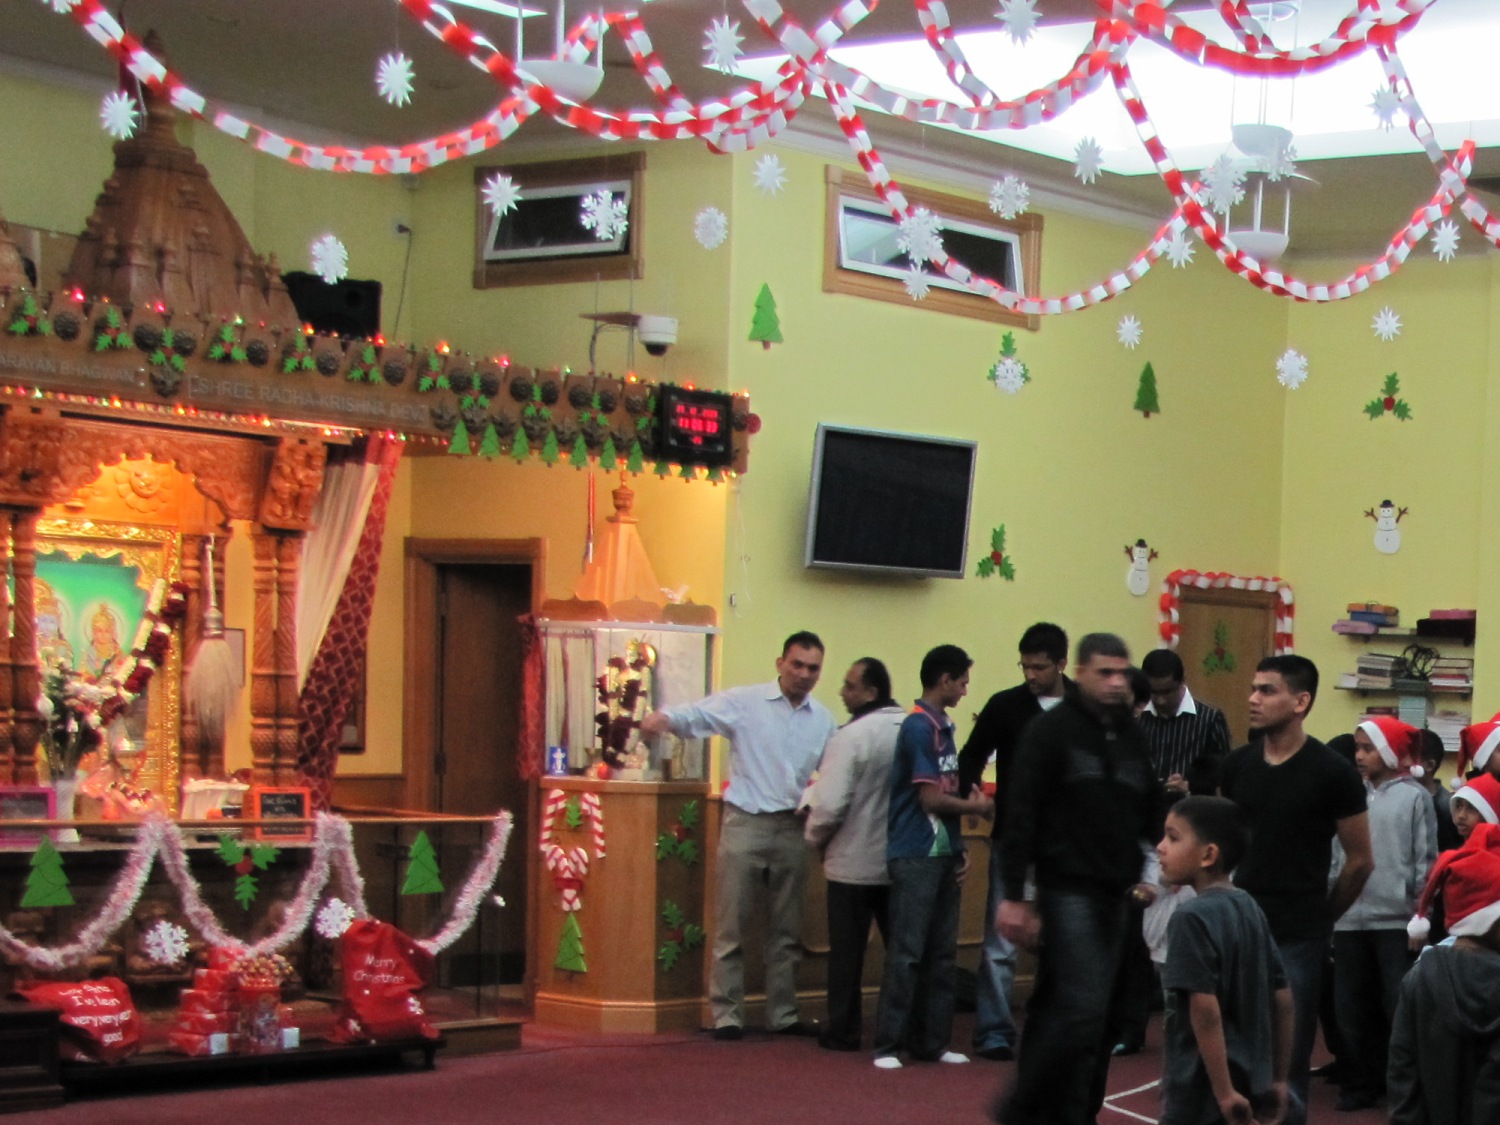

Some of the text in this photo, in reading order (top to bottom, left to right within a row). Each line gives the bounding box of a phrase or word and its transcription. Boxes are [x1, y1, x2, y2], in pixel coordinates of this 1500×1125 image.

[198, 377, 255, 401] SHREE
[364, 953, 397, 971] Merry
[353, 968, 406, 984] Christmas
